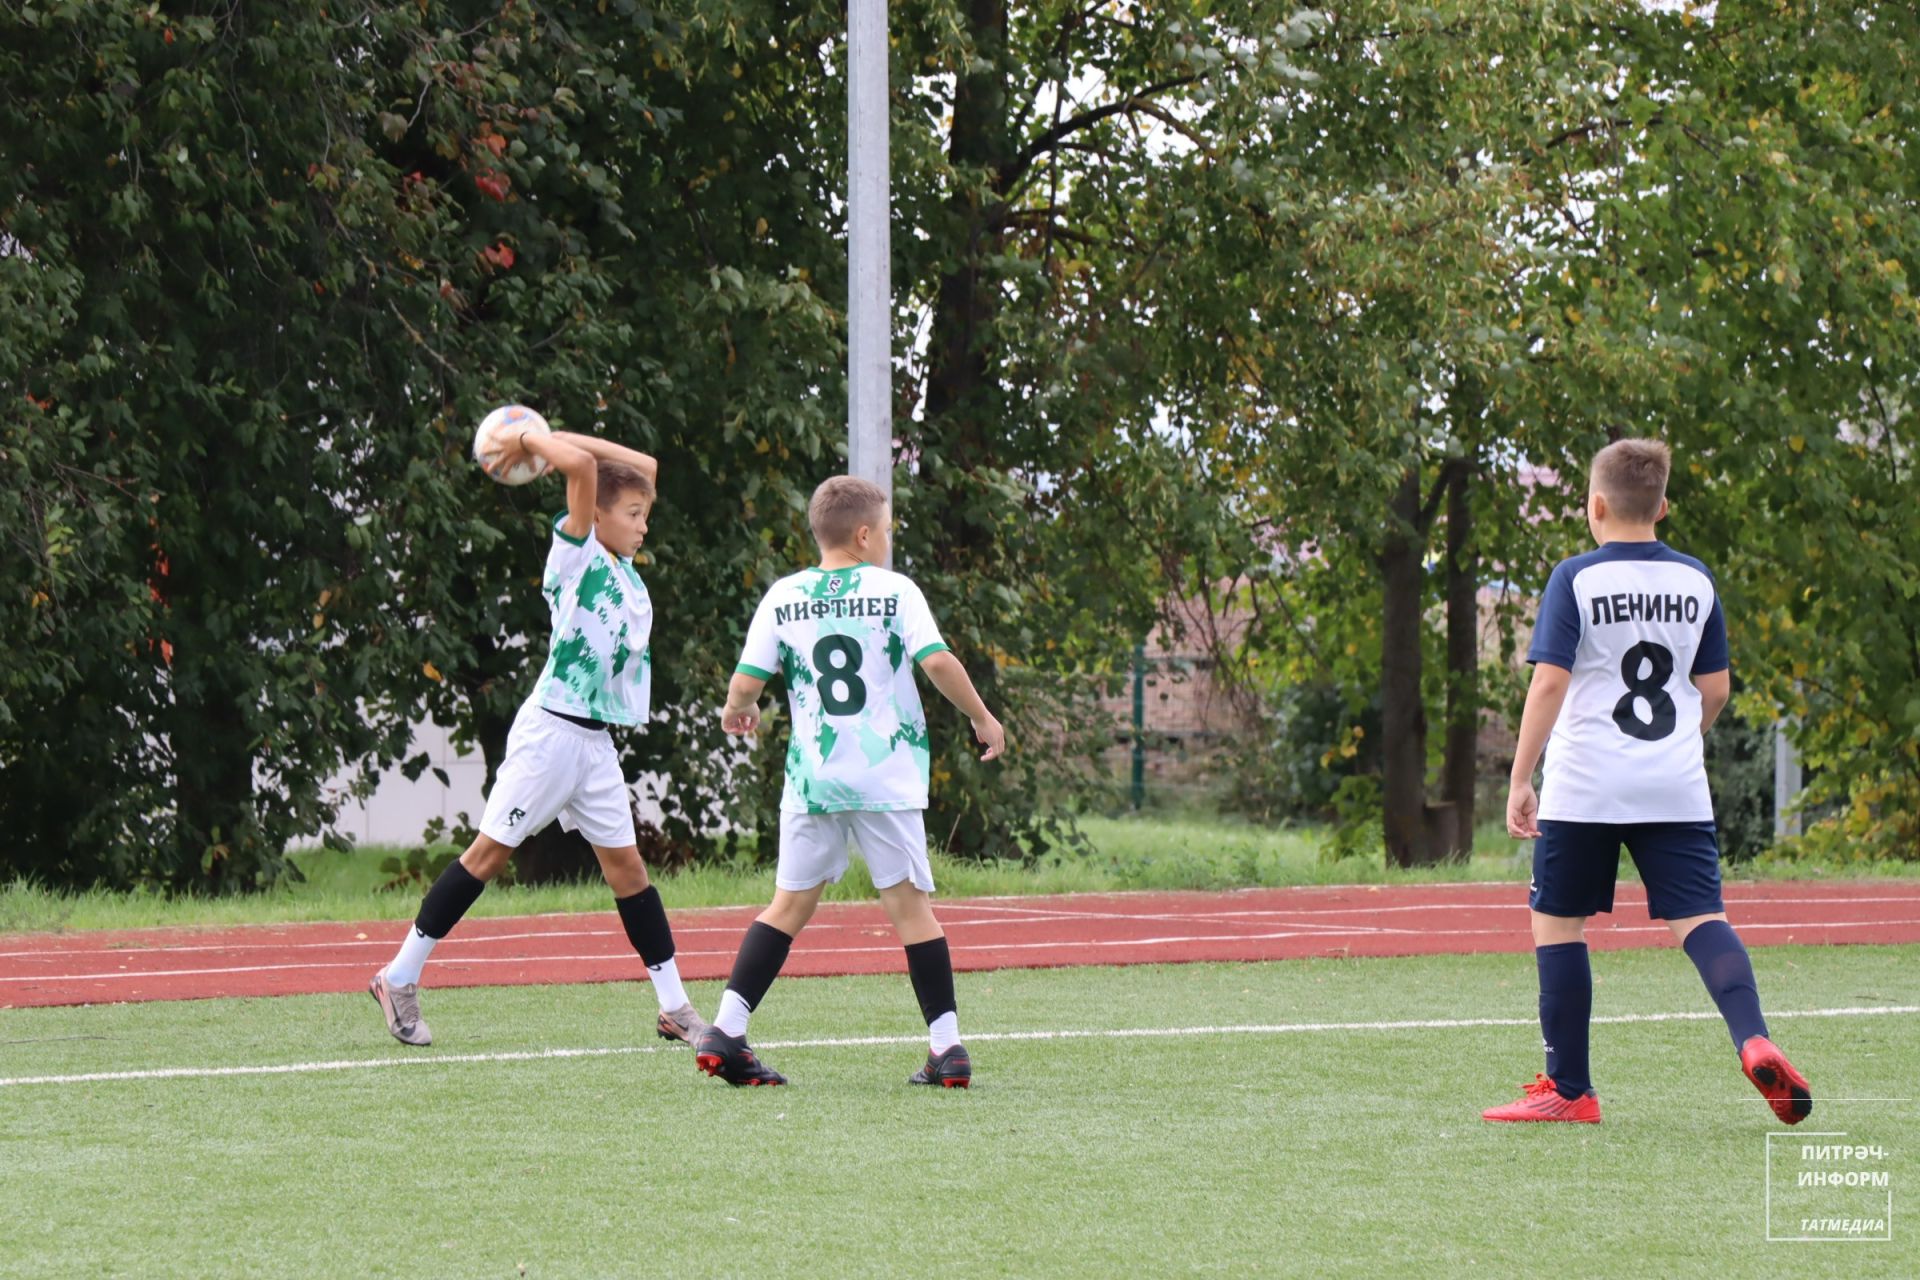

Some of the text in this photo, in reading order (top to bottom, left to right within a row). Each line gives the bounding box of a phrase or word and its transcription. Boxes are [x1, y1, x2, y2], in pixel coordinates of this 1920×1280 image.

[775, 598, 897, 625] МИФТИЕВ
[1591, 593, 1699, 625] ЛЕНИНО
[812, 634, 867, 716] 8
[1612, 640, 1677, 741] 8
